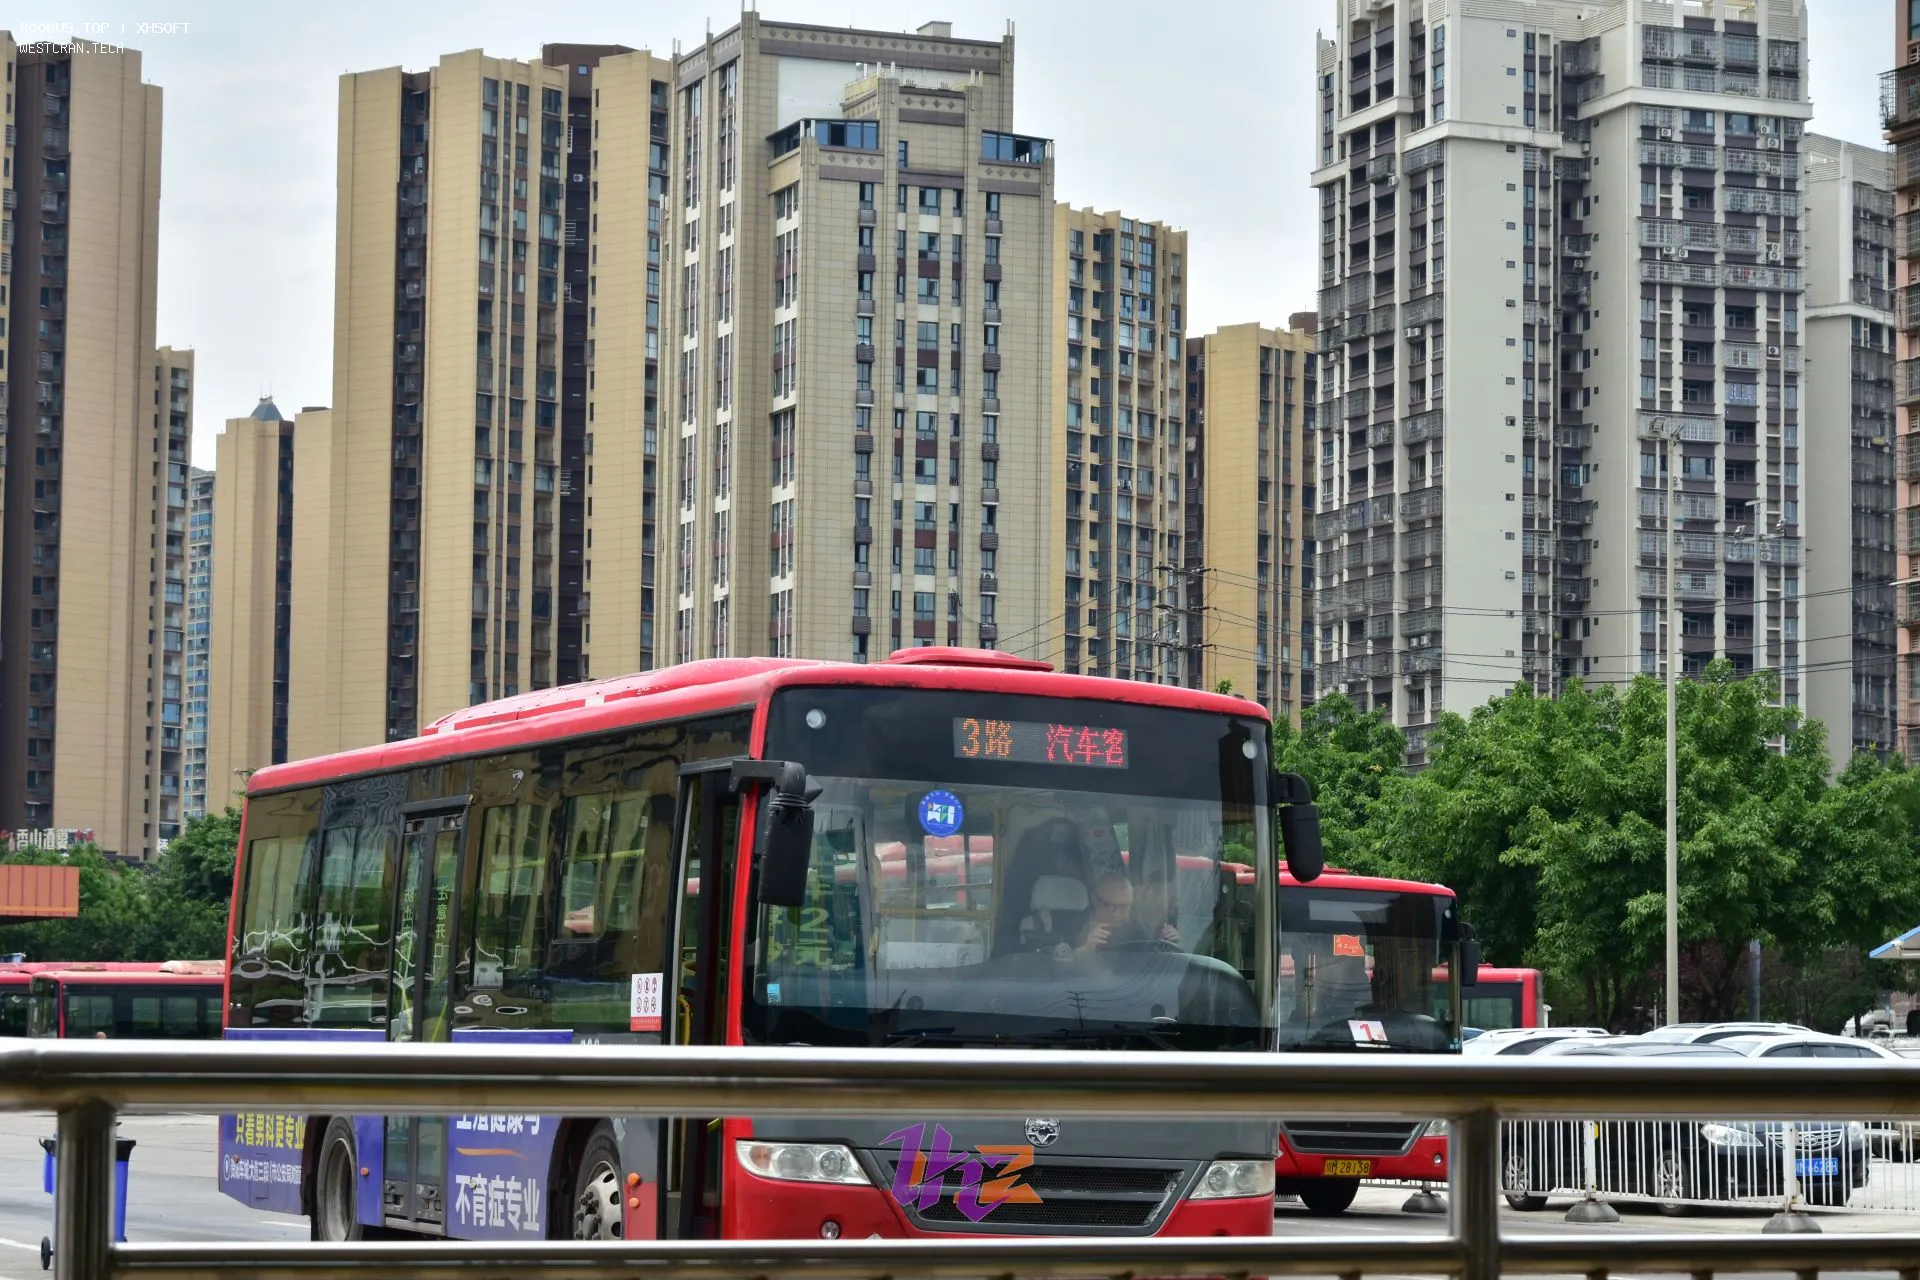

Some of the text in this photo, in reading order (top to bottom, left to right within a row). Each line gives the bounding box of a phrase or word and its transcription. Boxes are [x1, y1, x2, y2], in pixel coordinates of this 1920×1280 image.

[962, 718, 1013, 758] 3路
[455, 1173, 540, 1232] 不育症专业
